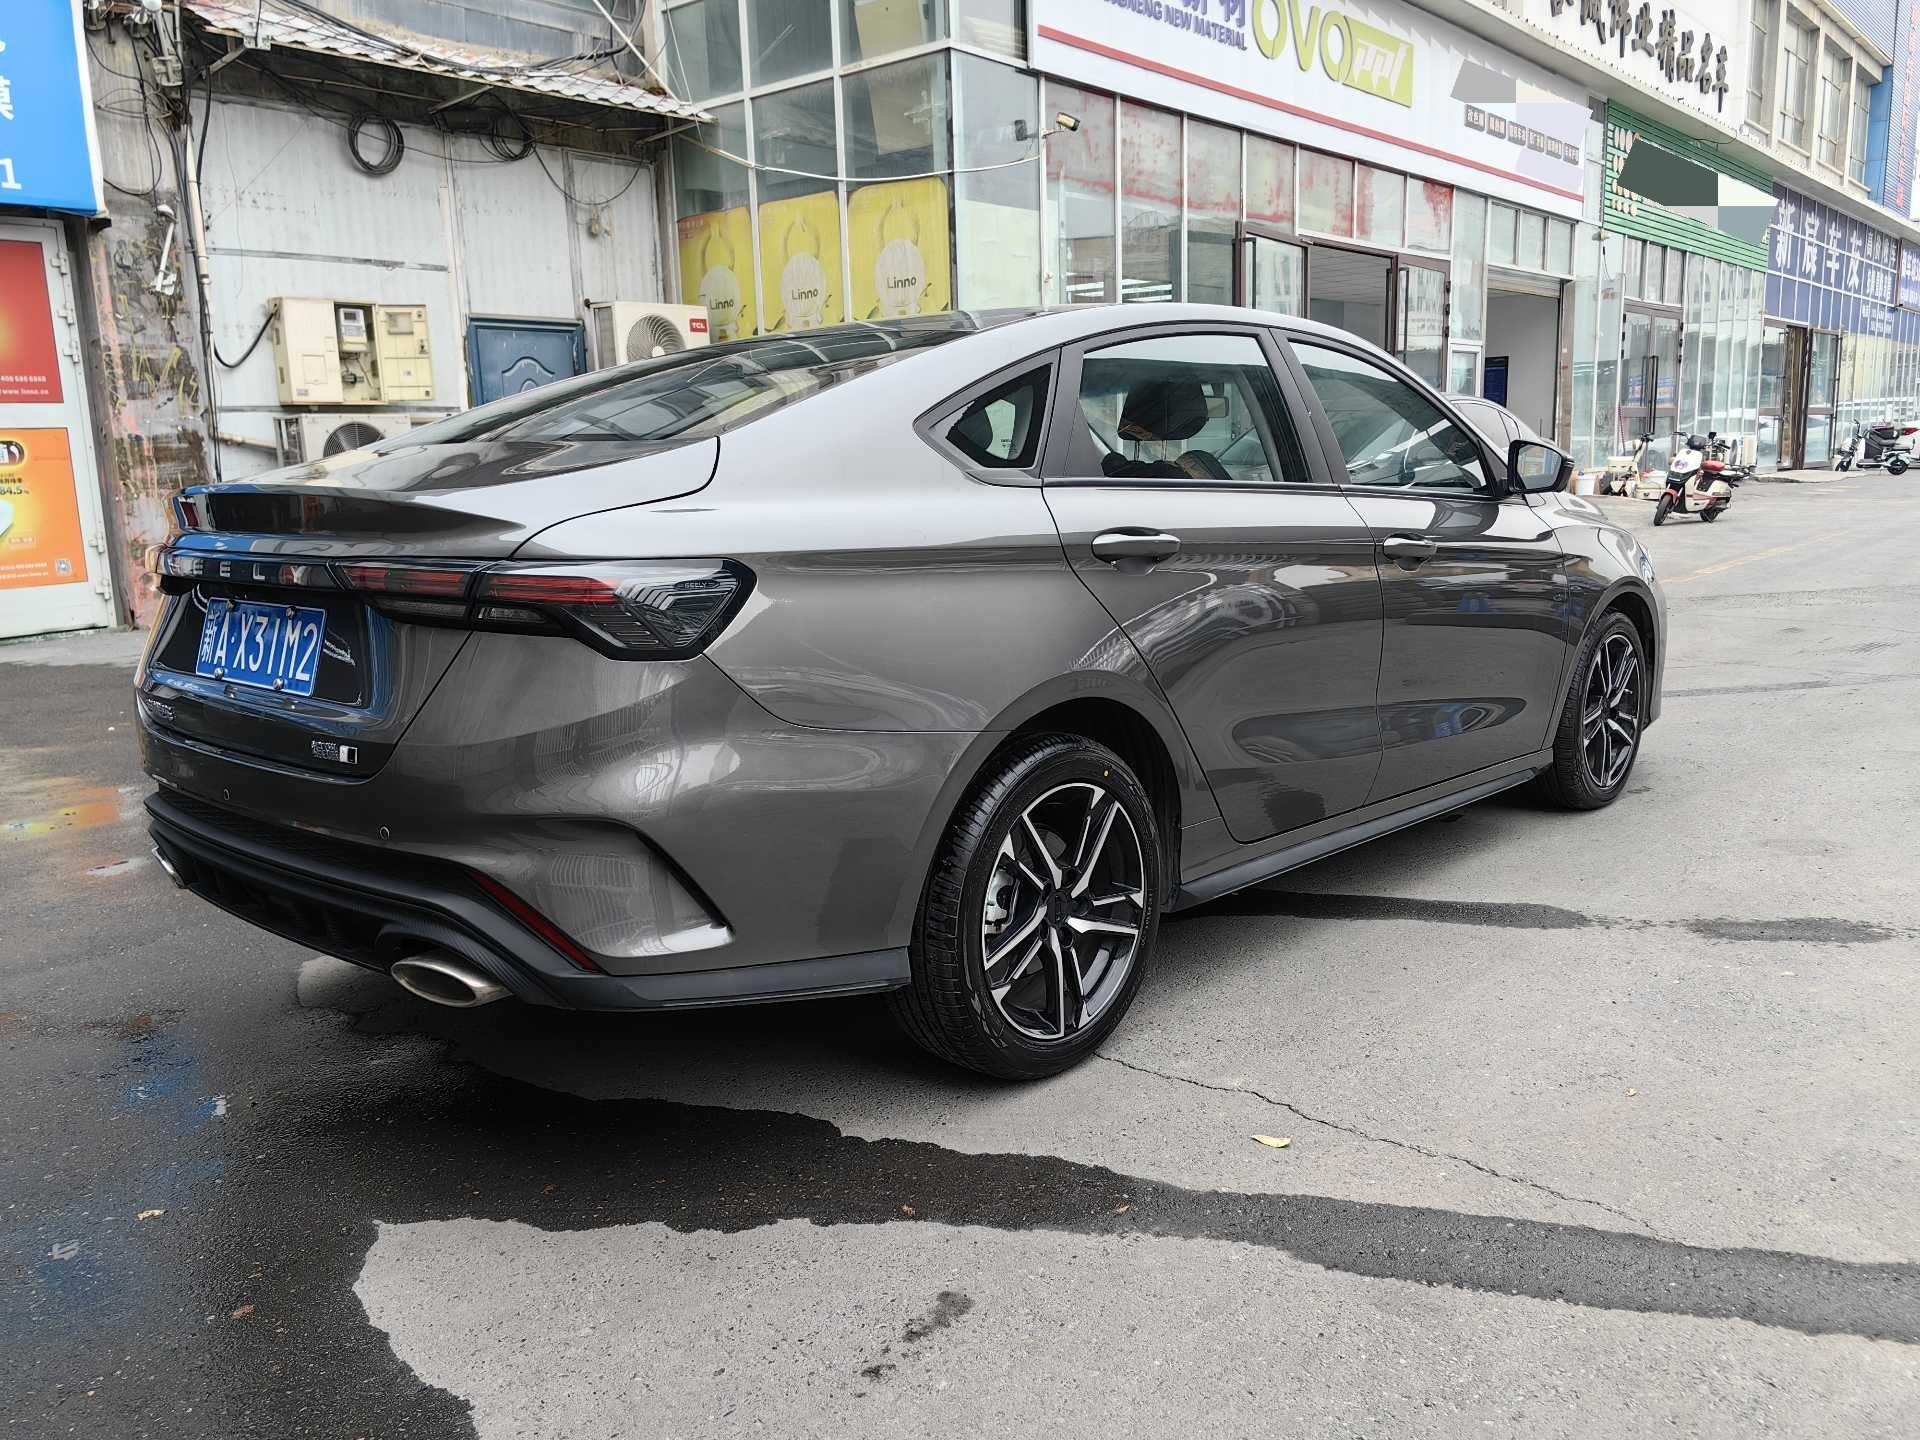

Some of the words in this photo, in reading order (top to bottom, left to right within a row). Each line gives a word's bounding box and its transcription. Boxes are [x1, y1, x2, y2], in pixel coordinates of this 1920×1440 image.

[1164, 4, 1192, 31] NEW
[1193, 15, 1247, 51] MATERIAL
[1252, 0, 1352, 81] OVO
[887, 275, 917, 289] Linno
[791, 288, 819, 300] Linno
[709, 299, 734, 311] Linno
[691, 322, 706, 330] TCL
